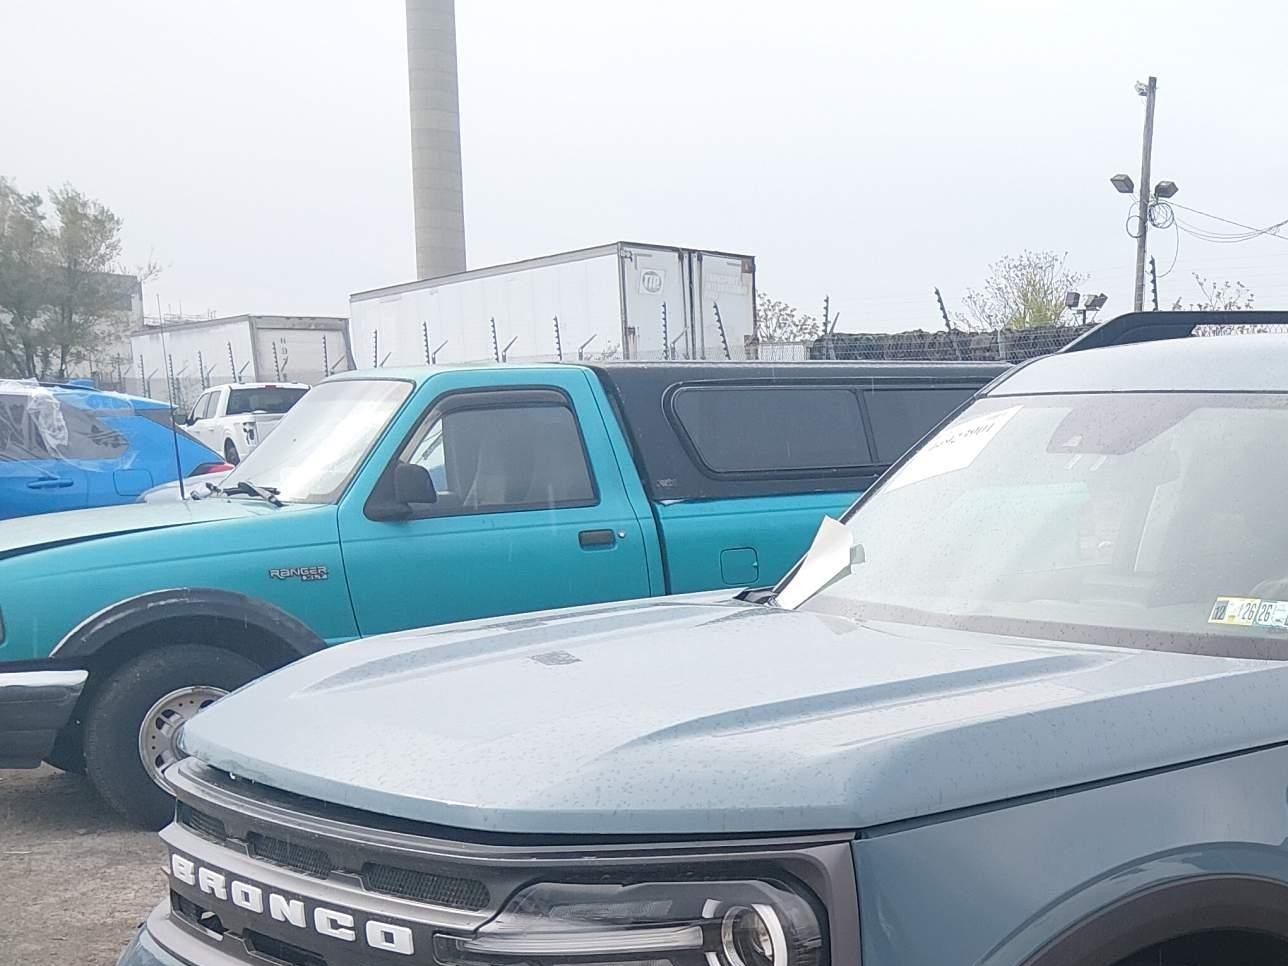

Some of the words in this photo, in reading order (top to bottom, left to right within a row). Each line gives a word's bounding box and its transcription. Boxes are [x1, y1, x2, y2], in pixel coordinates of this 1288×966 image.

[270, 566, 327, 579] RANGER
[1258, 603, 1273, 622] 26
[171, 853, 416, 956] BRONCO
